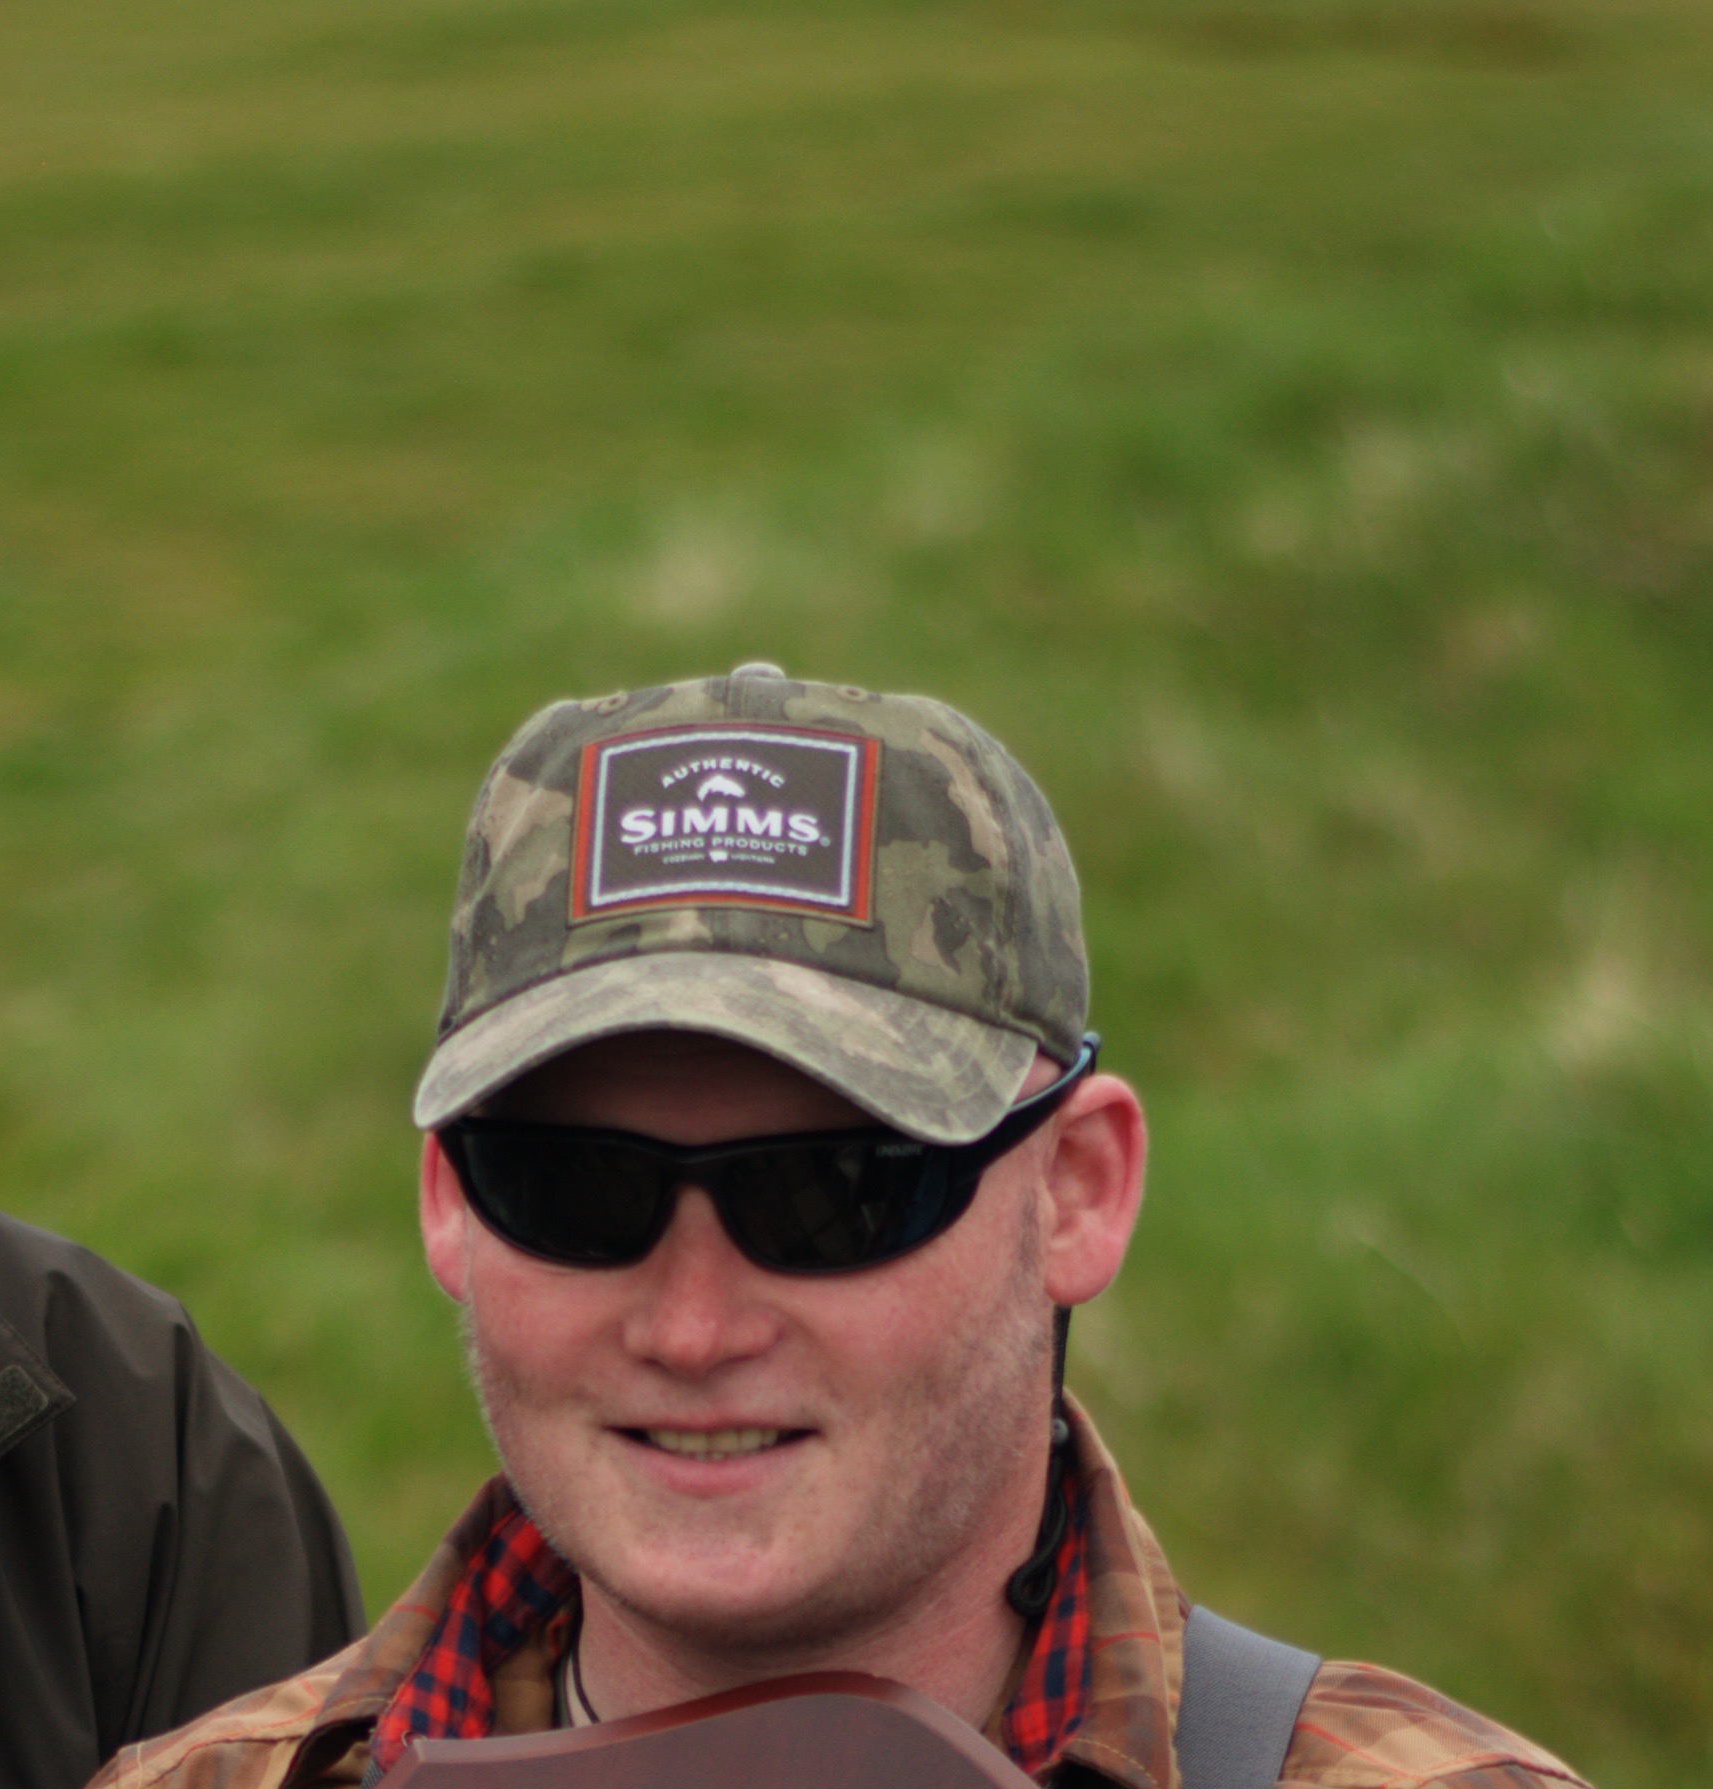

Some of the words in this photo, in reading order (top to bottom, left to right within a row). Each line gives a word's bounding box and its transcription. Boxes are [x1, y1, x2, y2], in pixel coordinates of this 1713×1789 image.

[662, 757, 786, 789] AUTHENTIC
[620, 806, 820, 844] SIMMS
[633, 836, 705, 856] FISHING
[711, 836, 810, 857] PRODUCTS
